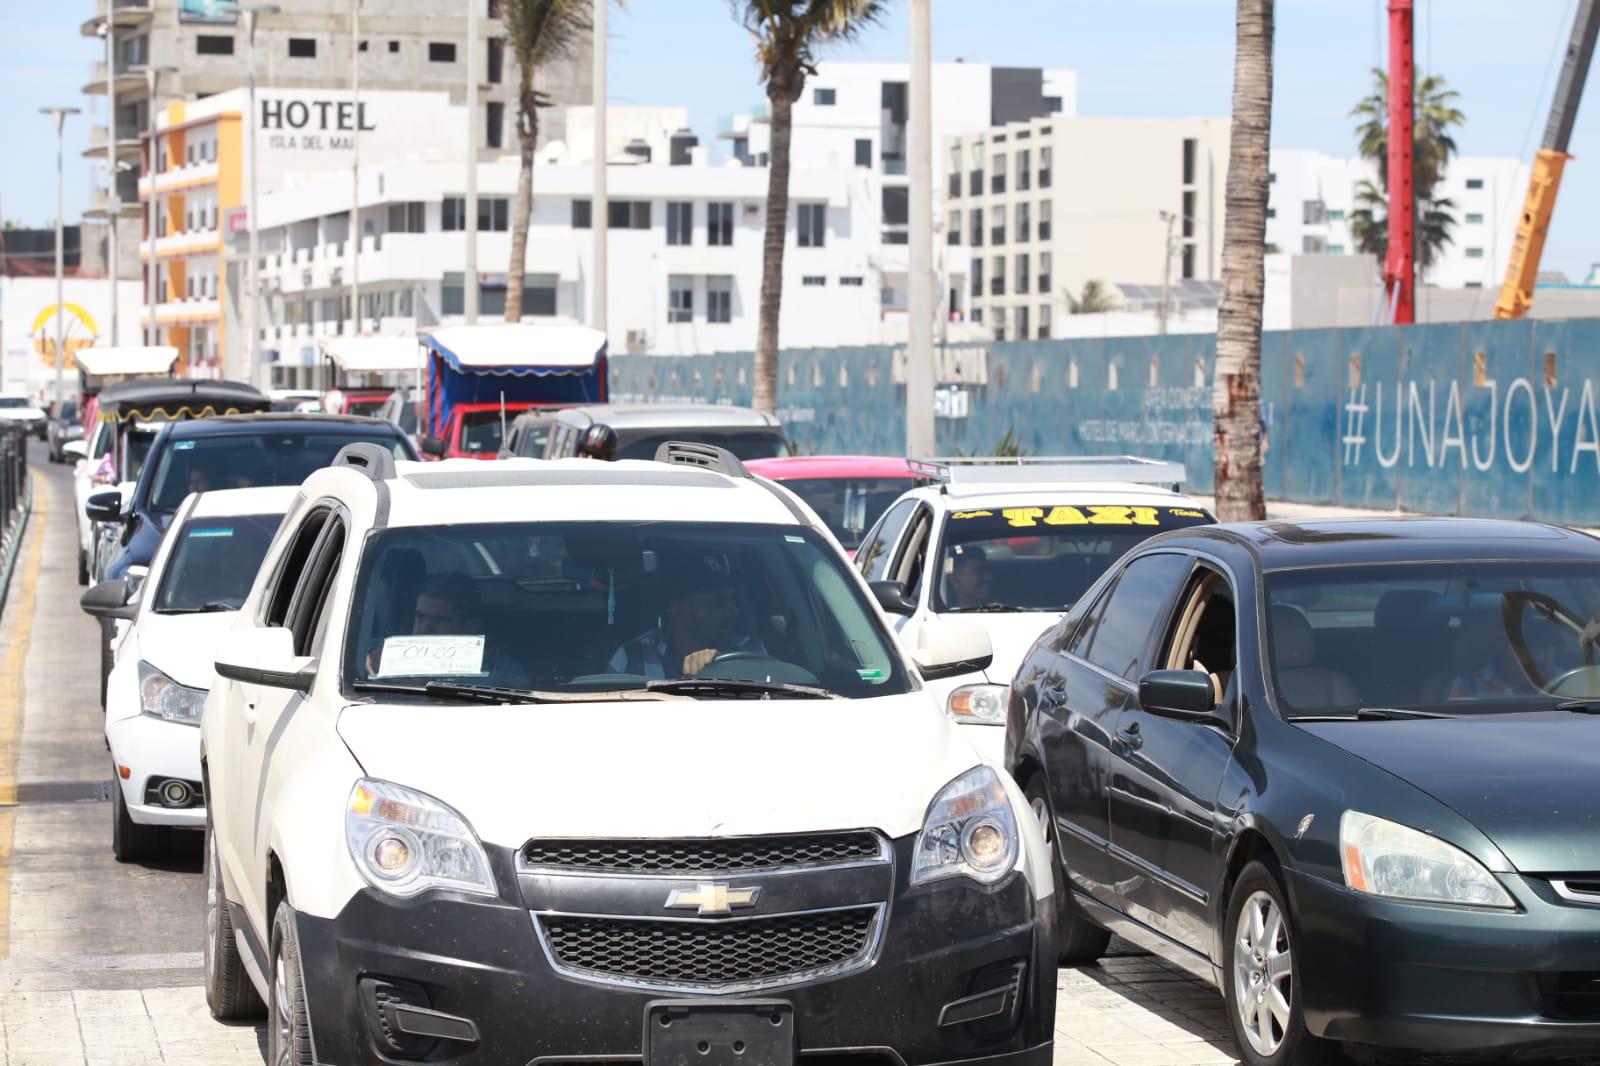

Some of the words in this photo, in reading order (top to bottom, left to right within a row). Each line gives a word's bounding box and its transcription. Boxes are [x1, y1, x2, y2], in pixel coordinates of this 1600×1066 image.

[261, 100, 376, 131] HOTEL
[302, 136, 323, 150] DEL
[1342, 378, 1600, 474] #UNAJOYA
[1002, 506, 1160, 527] TAXI
